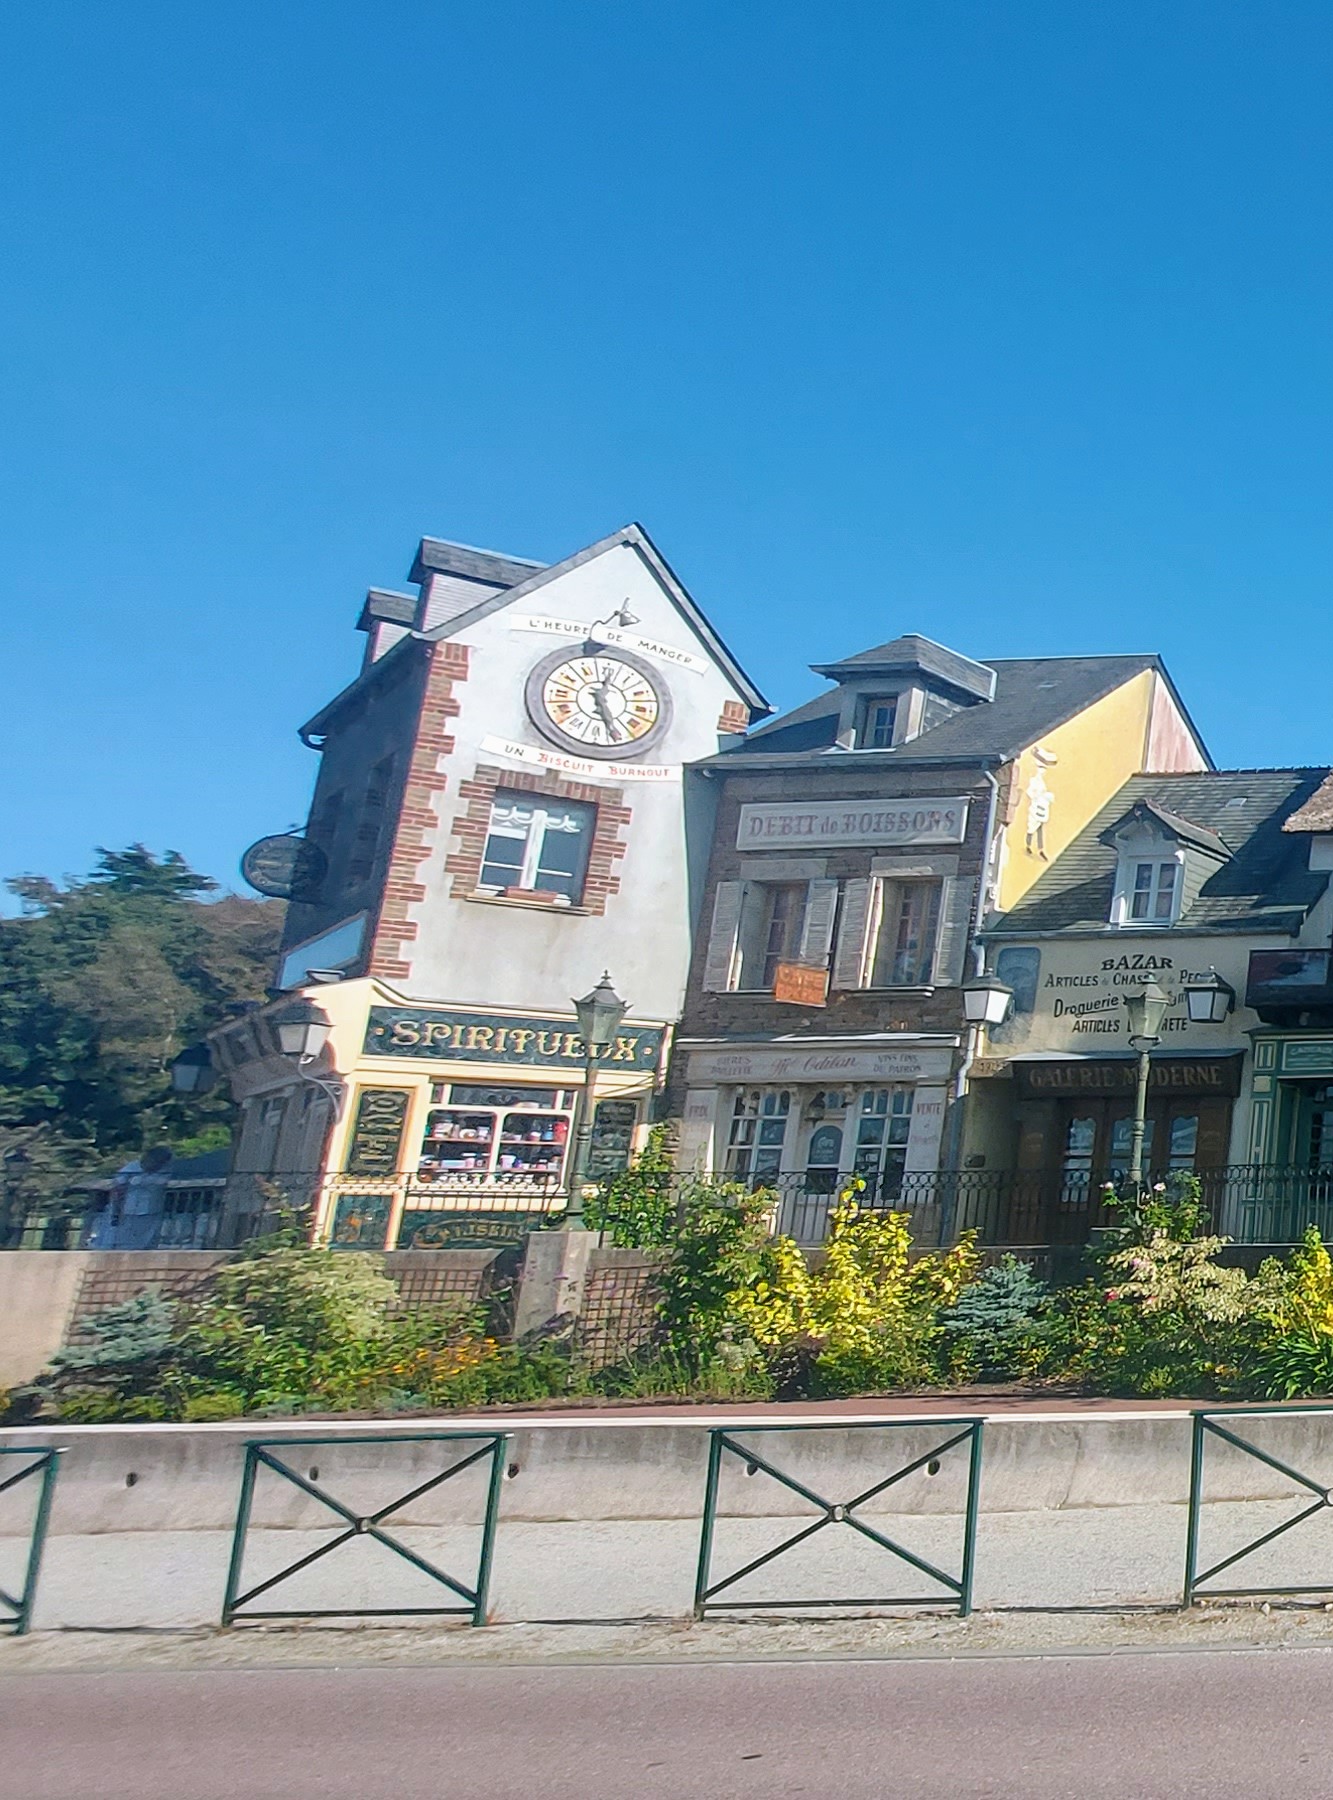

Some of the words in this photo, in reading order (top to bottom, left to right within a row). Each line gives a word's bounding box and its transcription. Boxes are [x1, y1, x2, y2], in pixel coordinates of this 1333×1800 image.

[529, 619, 589, 634] L'HEURE
[606, 632, 623, 643] DE
[637, 640, 692, 664] MANGER
[504, 745, 524, 757] UN
[538, 753, 595, 773] BISCUIT
[750, 815, 819, 837] DEBIT
[821, 816, 838, 834] de
[841, 810, 956, 834] BOISSONS
[1101, 954, 1173, 970] BAZAR
[1044, 973, 1098, 988] ARTICLES
[1054, 993, 1119, 1018] Droguerie
[1072, 1018, 1120, 1033] ARTICLES
[1029, 1068, 1115, 1088] GALERIE
